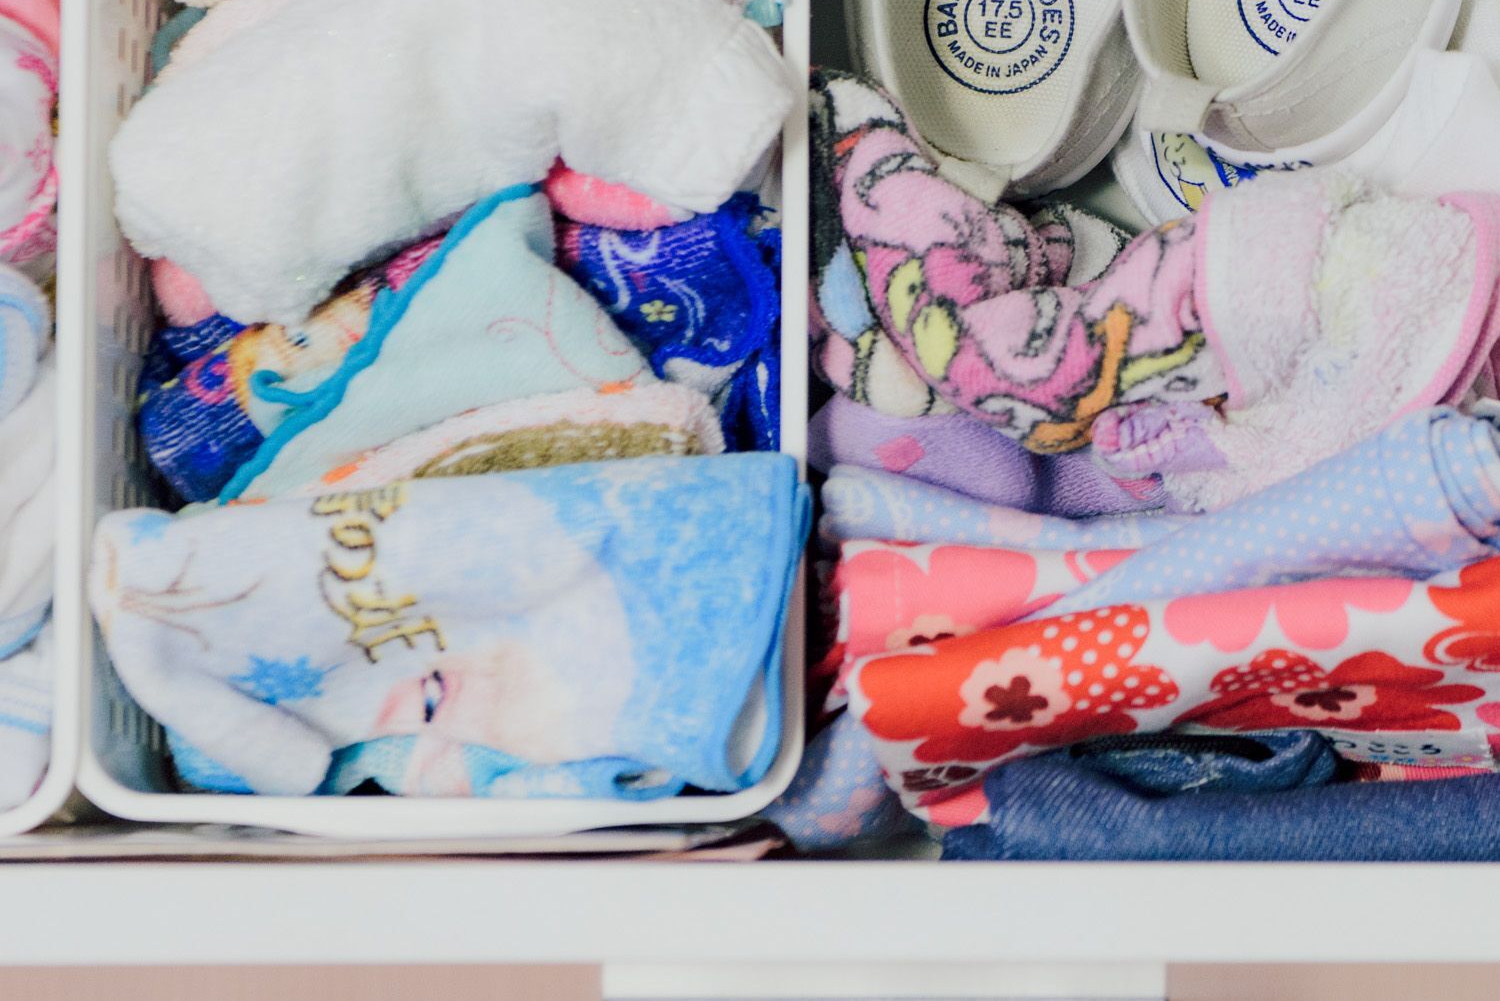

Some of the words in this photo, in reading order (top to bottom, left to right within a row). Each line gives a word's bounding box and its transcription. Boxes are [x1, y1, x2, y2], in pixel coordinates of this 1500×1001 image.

[983, 21, 1013, 39] EE
[1255, 0, 1287, 39] MADE
[947, 39, 985, 75] MADE
[985, 64, 1001, 78] IN
[1005, 44, 1049, 78] JAPAN
